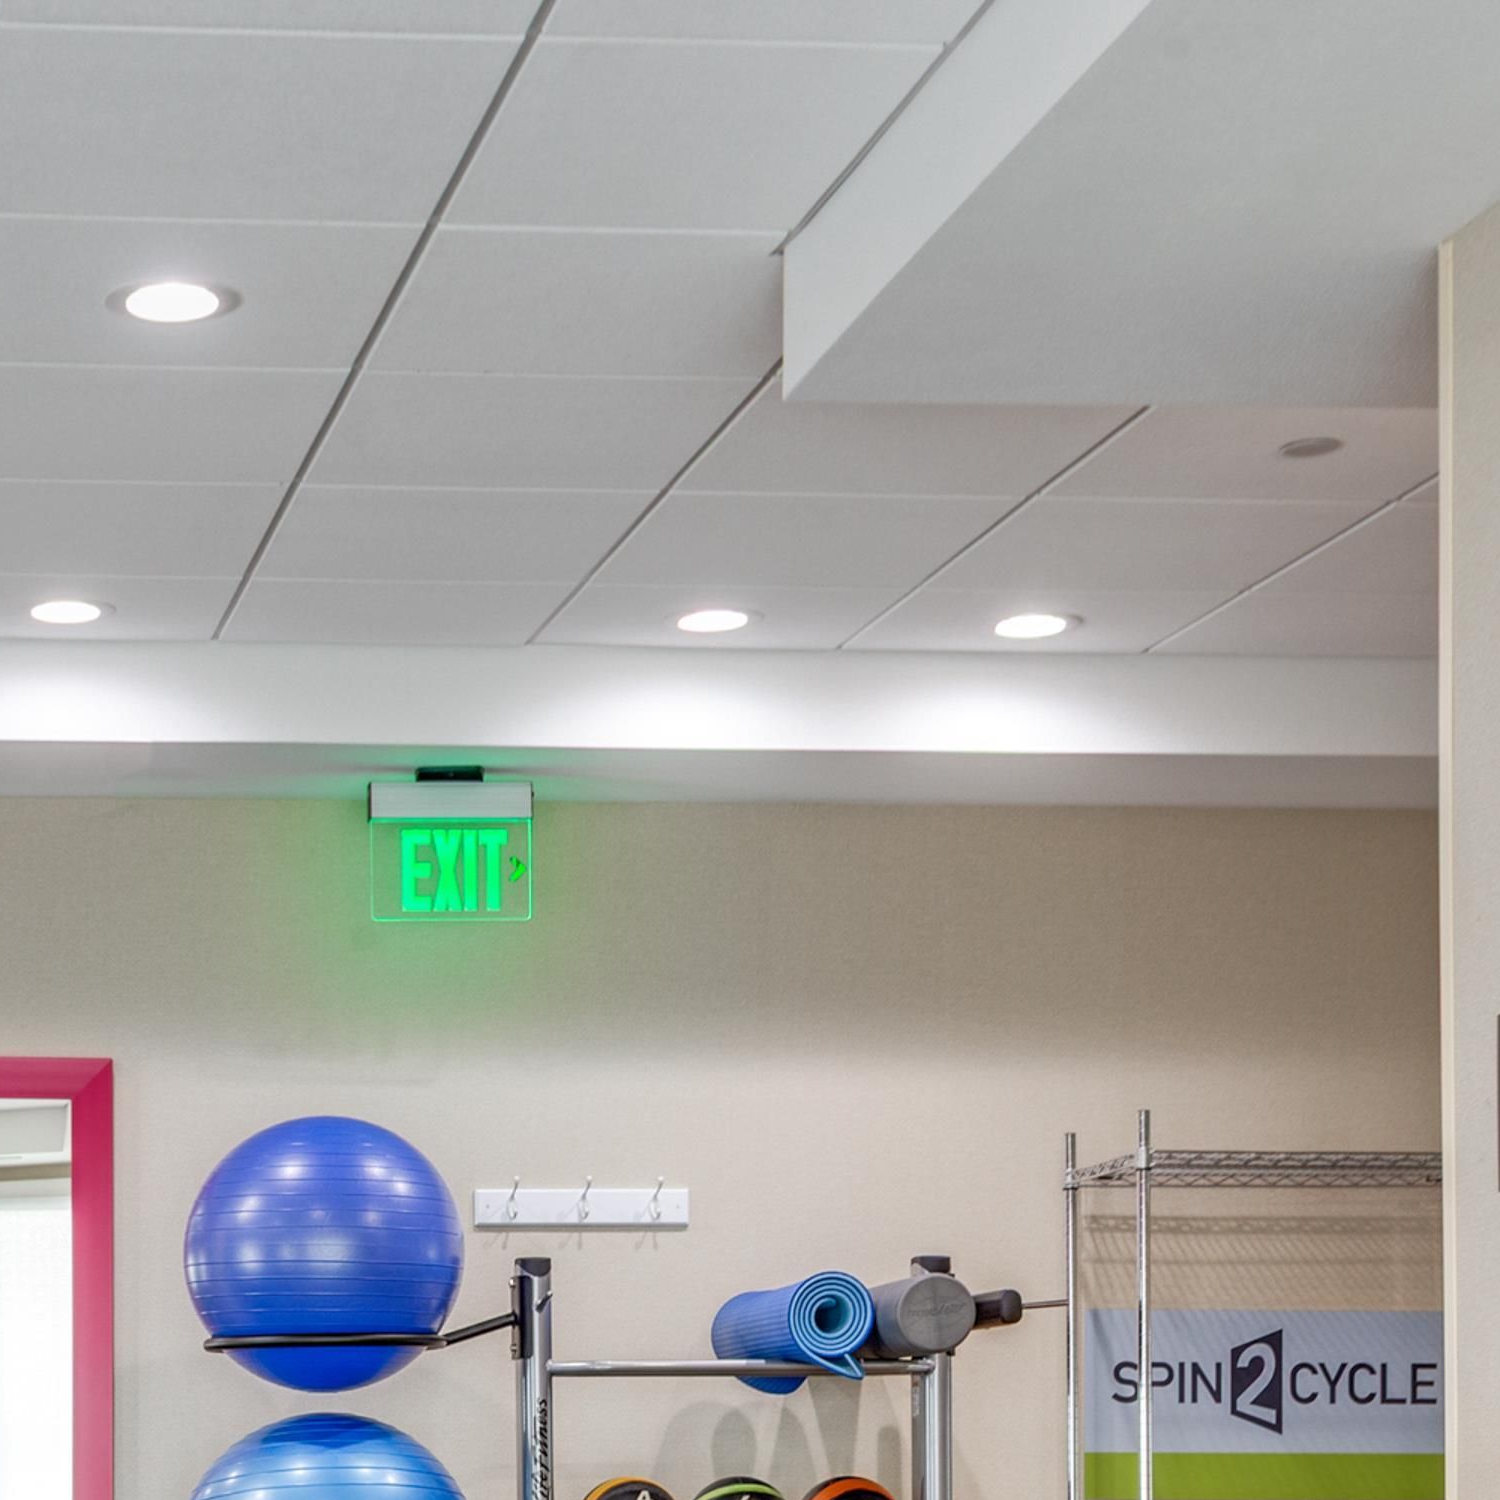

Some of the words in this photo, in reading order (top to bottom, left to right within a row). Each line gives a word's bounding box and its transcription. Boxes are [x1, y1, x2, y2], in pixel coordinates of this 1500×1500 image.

[402, 829, 508, 912] EXIT
[1112, 1361, 1222, 1404] SPIN
[1234, 1341, 1278, 1425] 2
[1290, 1362, 1438, 1405] CYCLE
